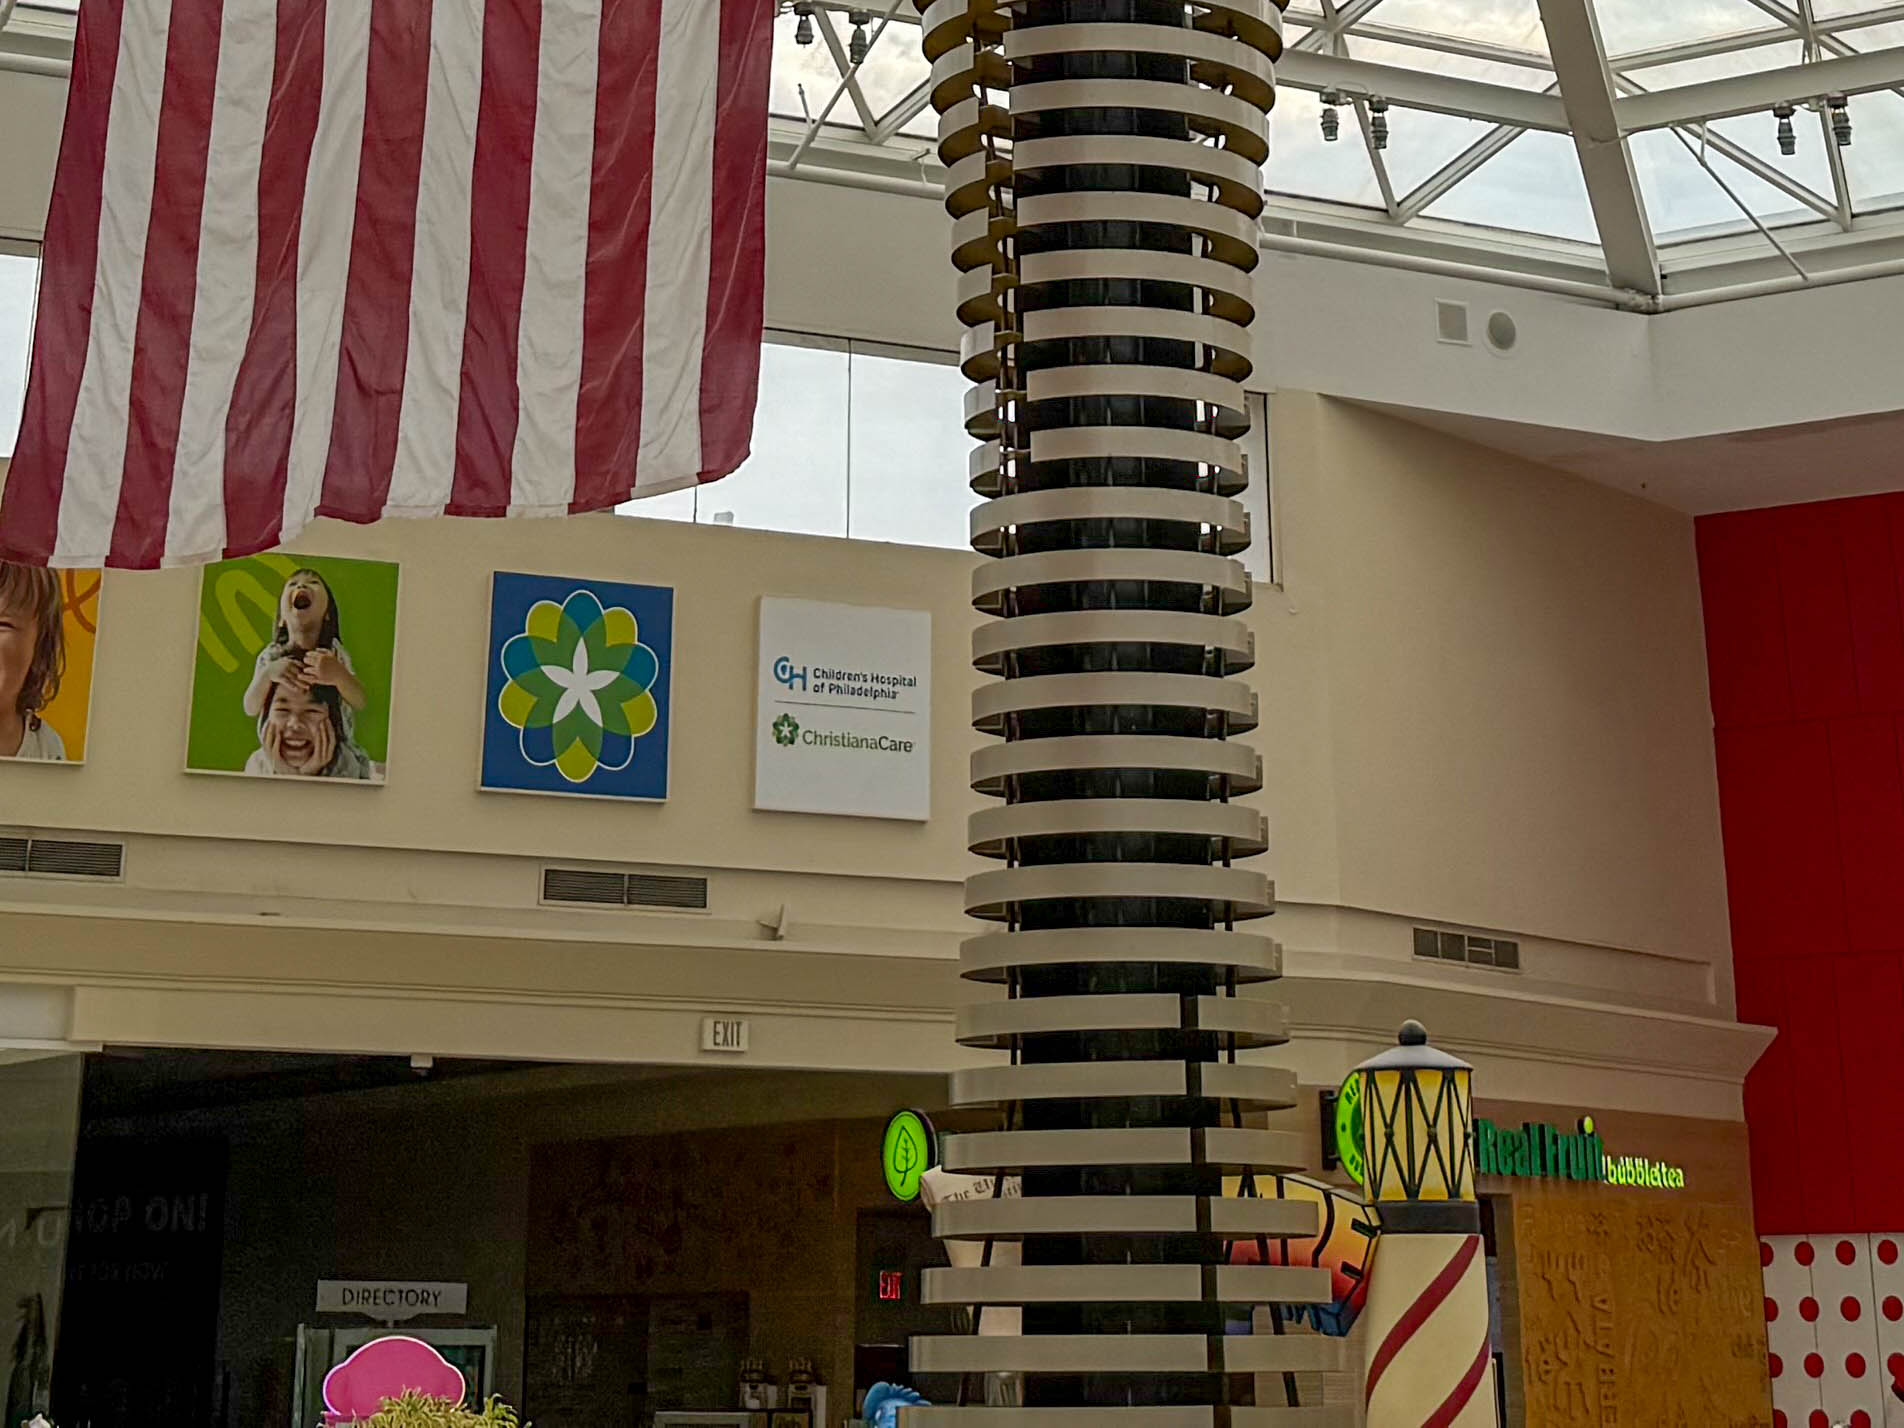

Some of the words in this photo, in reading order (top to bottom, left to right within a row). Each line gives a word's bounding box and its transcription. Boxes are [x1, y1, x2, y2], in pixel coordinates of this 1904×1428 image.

[813, 667, 868, 684] Children's
[871, 672, 917, 688] Hospital
[813, 682, 825, 694] of
[829, 683, 898, 701] Philadelphia
[802, 729, 913, 753] ChristianaCare
[713, 1020, 743, 1047] EXIT
[1477, 1118, 1541, 1176] Real
[342, 1287, 443, 1308] DIRECTORY
